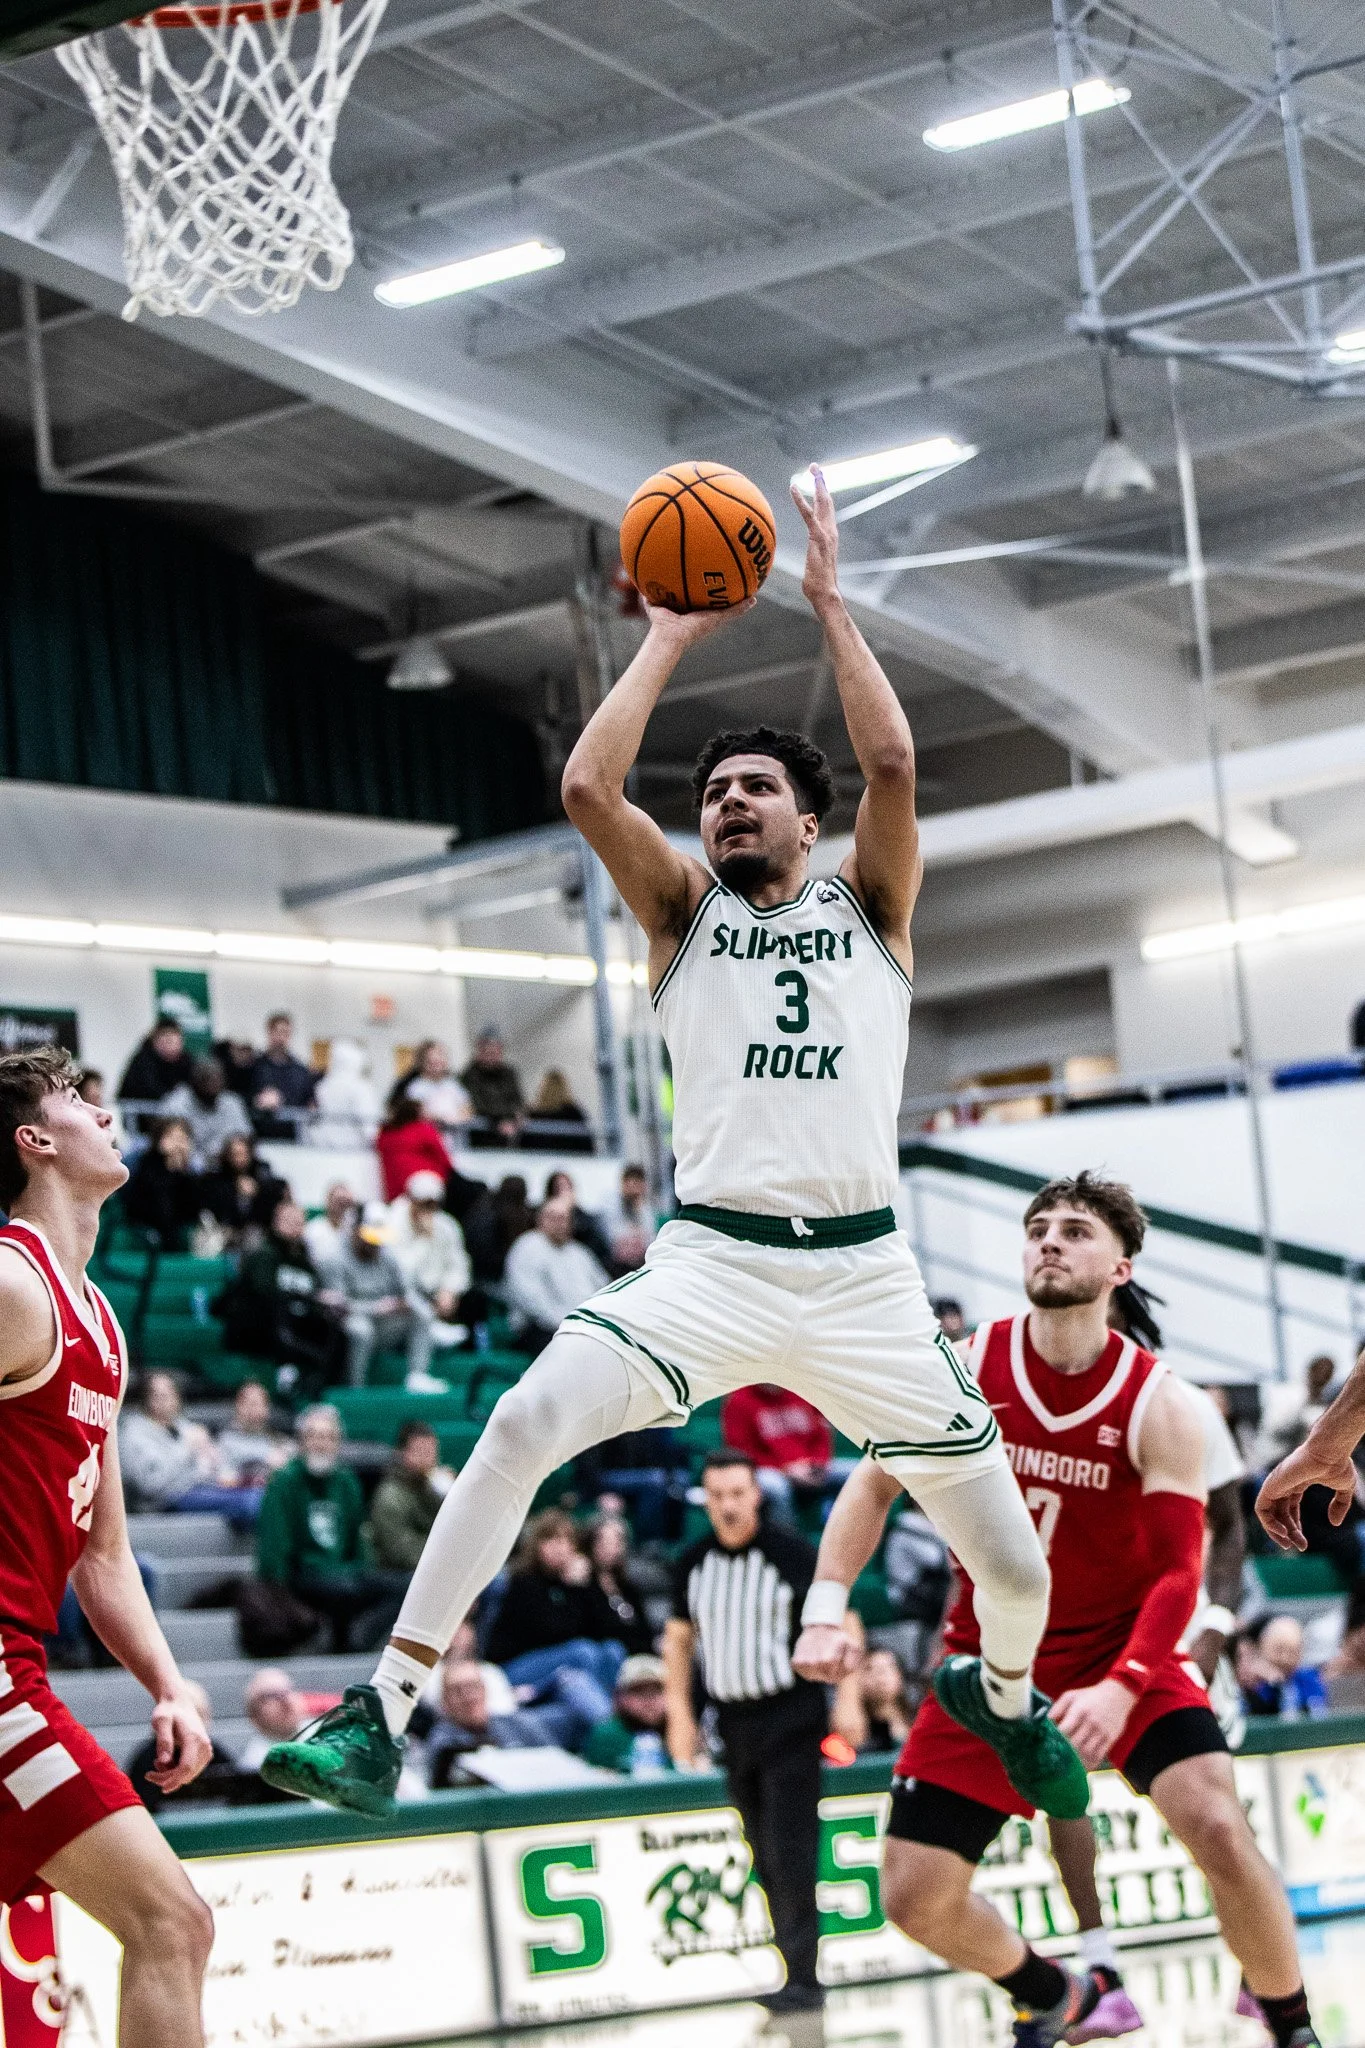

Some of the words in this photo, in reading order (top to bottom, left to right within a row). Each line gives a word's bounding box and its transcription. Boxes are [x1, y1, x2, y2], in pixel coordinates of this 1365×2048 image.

[710, 922, 852, 964] SLIPPERY
[774, 969, 810, 1034] 3
[743, 1043, 845, 1080] ROCK
[1001, 1441, 1111, 1491] DINBORO
[521, 1843, 606, 1976] S
